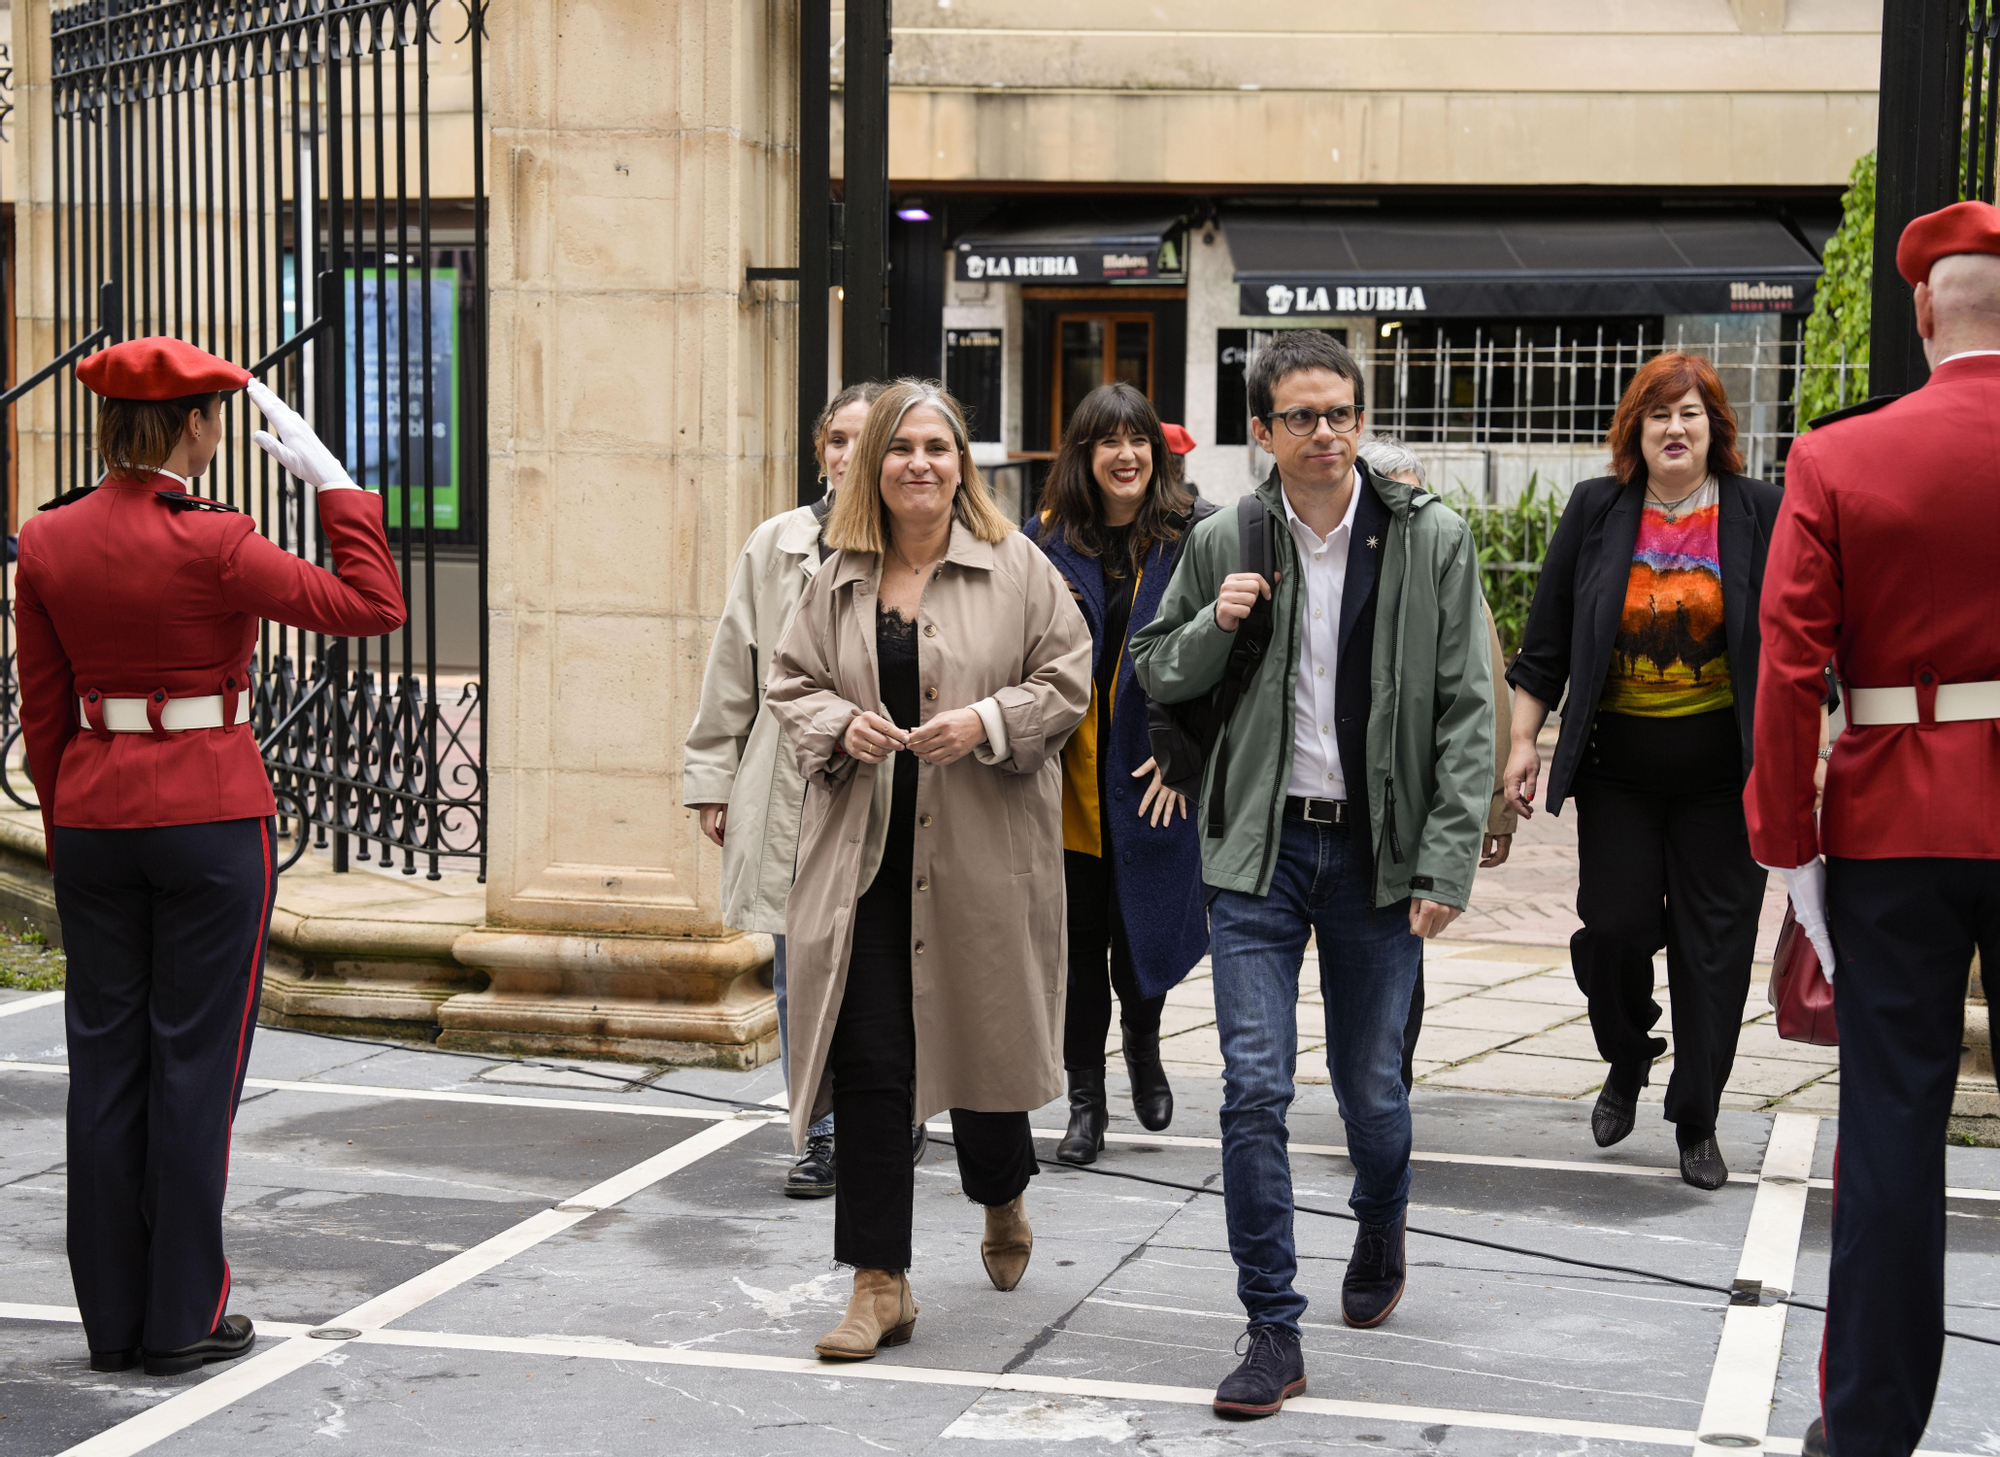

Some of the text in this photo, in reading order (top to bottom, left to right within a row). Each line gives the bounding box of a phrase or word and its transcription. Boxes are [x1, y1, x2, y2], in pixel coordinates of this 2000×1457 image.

[985, 255, 1079, 277] LA RUBIA
[1295, 286, 1427, 311] LA RUBIA
[1729, 281, 1794, 300] Mahou
[1730, 301, 1765, 311] DESDE
